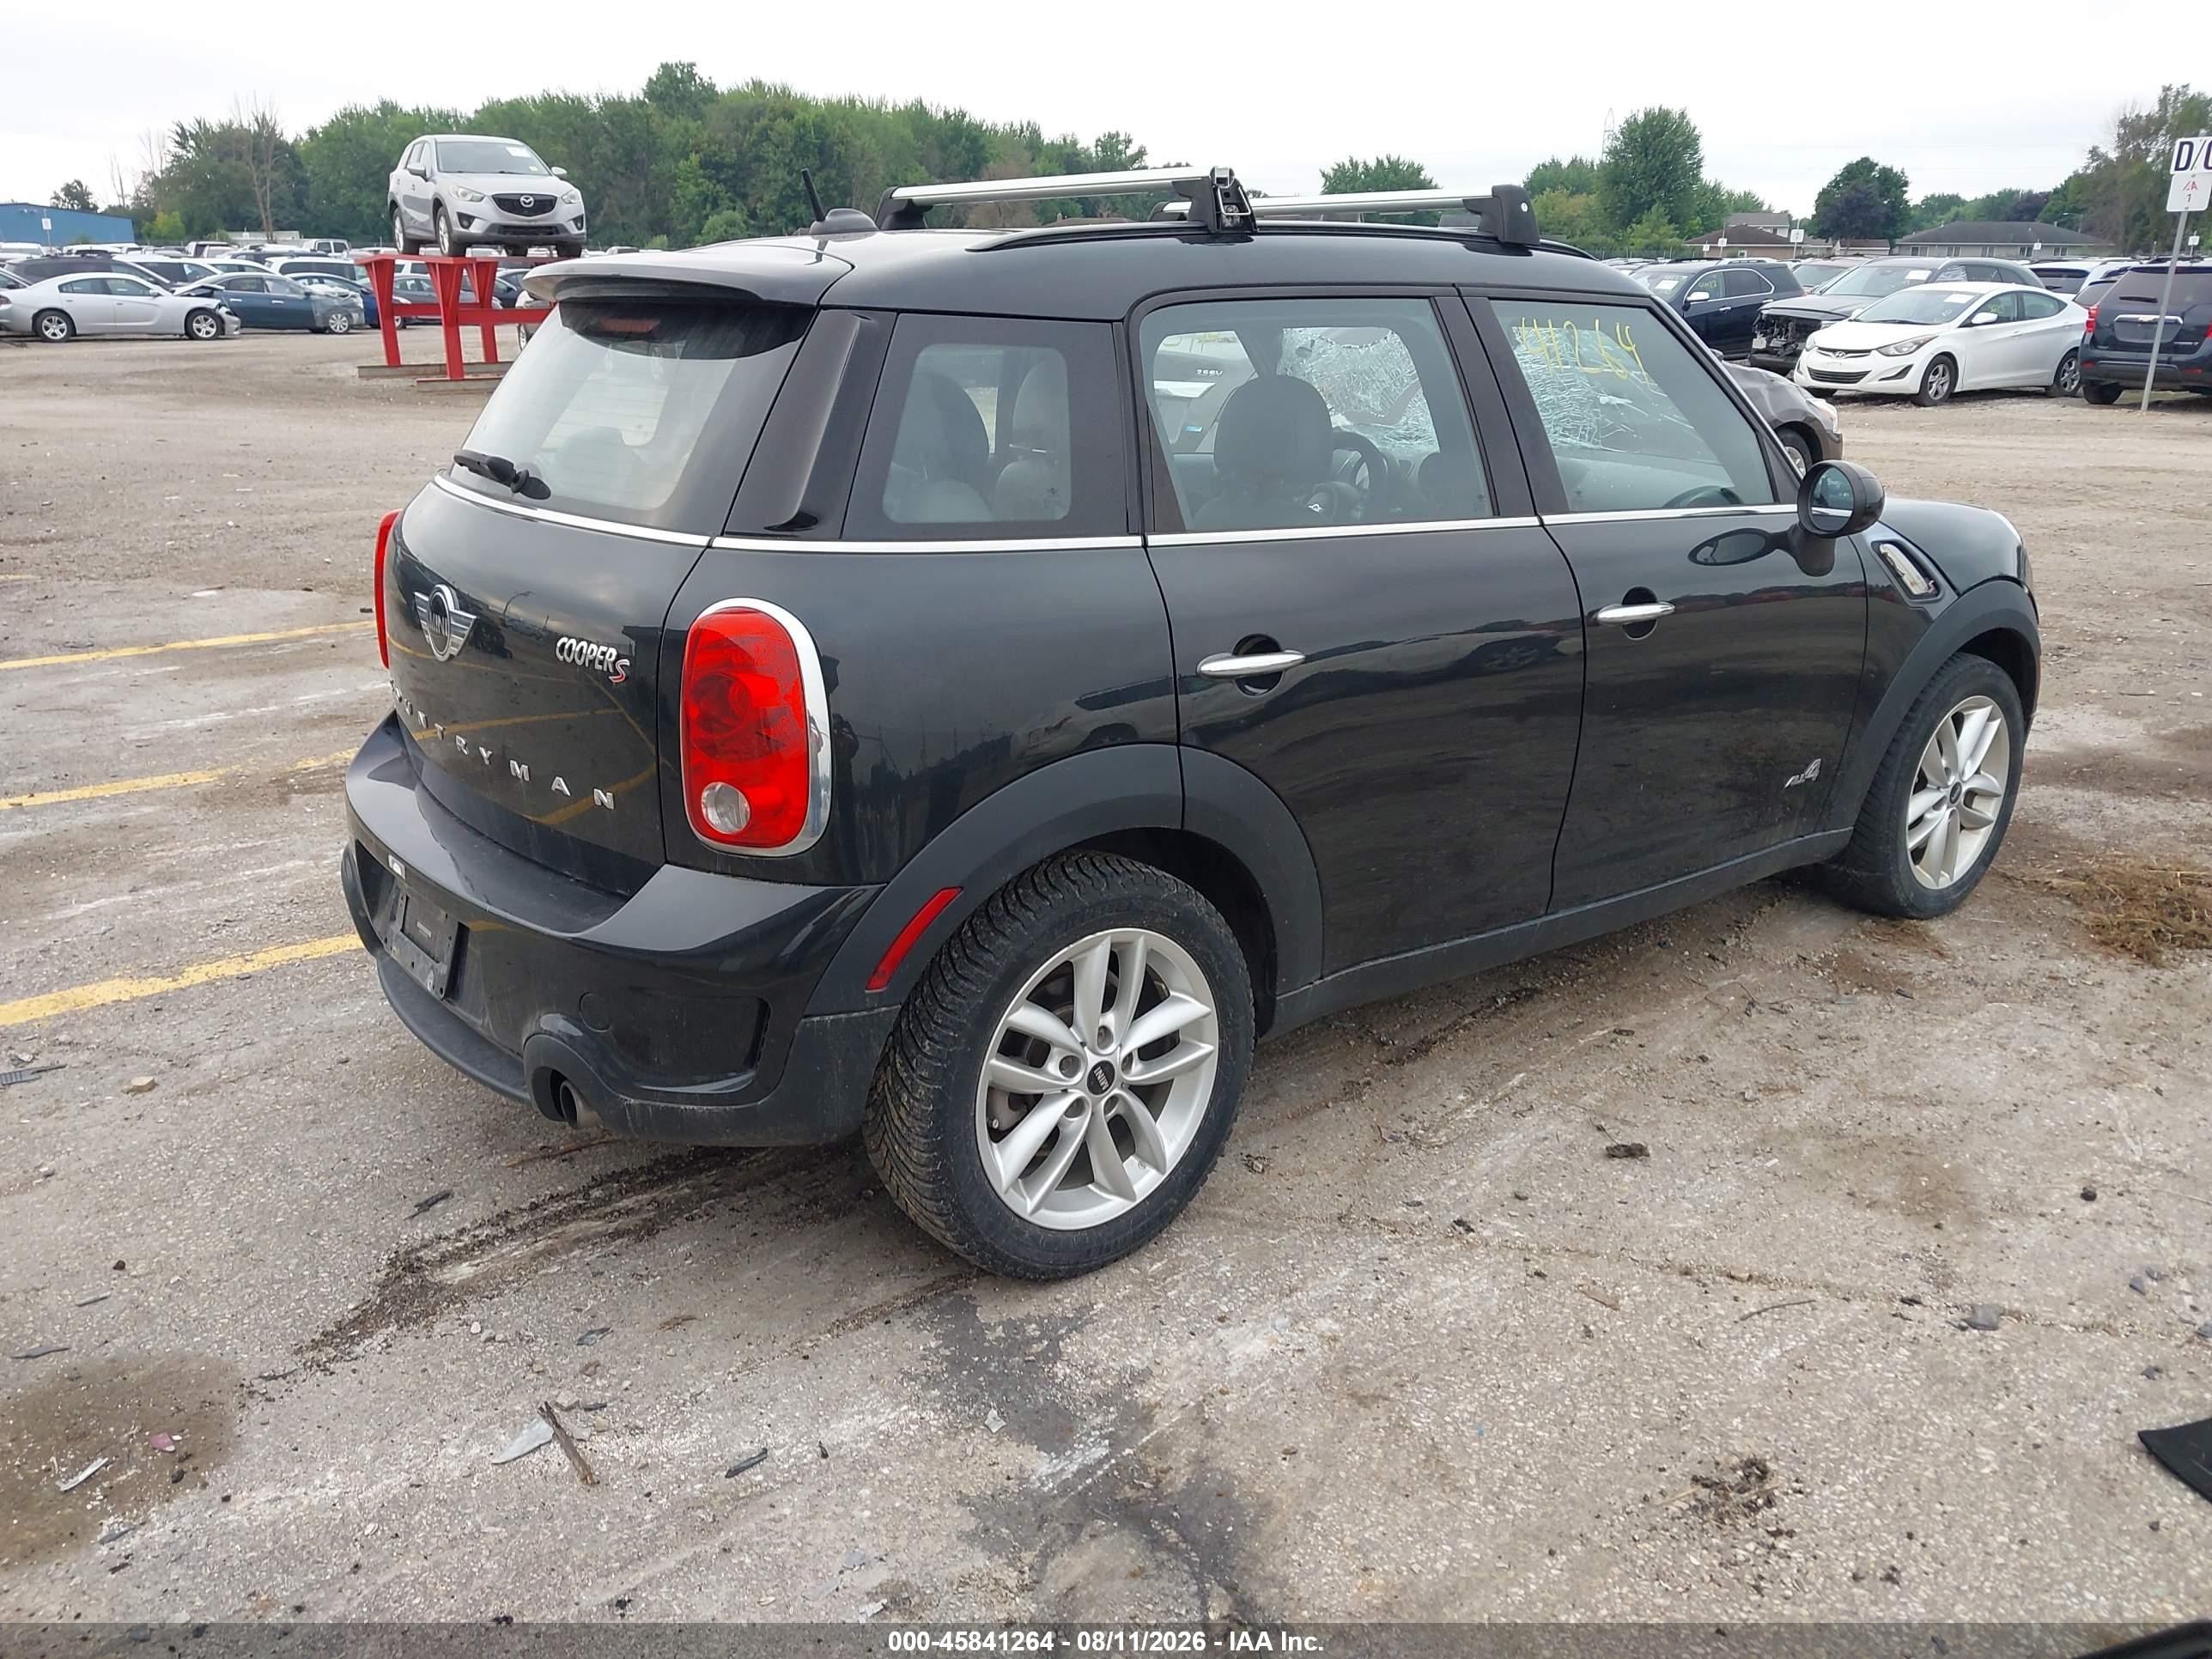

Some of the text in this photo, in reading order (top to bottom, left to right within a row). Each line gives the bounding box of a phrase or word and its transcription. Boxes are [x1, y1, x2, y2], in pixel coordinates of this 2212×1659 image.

[1522, 317, 1650, 384] 41264
[556, 636, 630, 683] COOPER S
[1093, 1066, 1109, 1091] MINI
